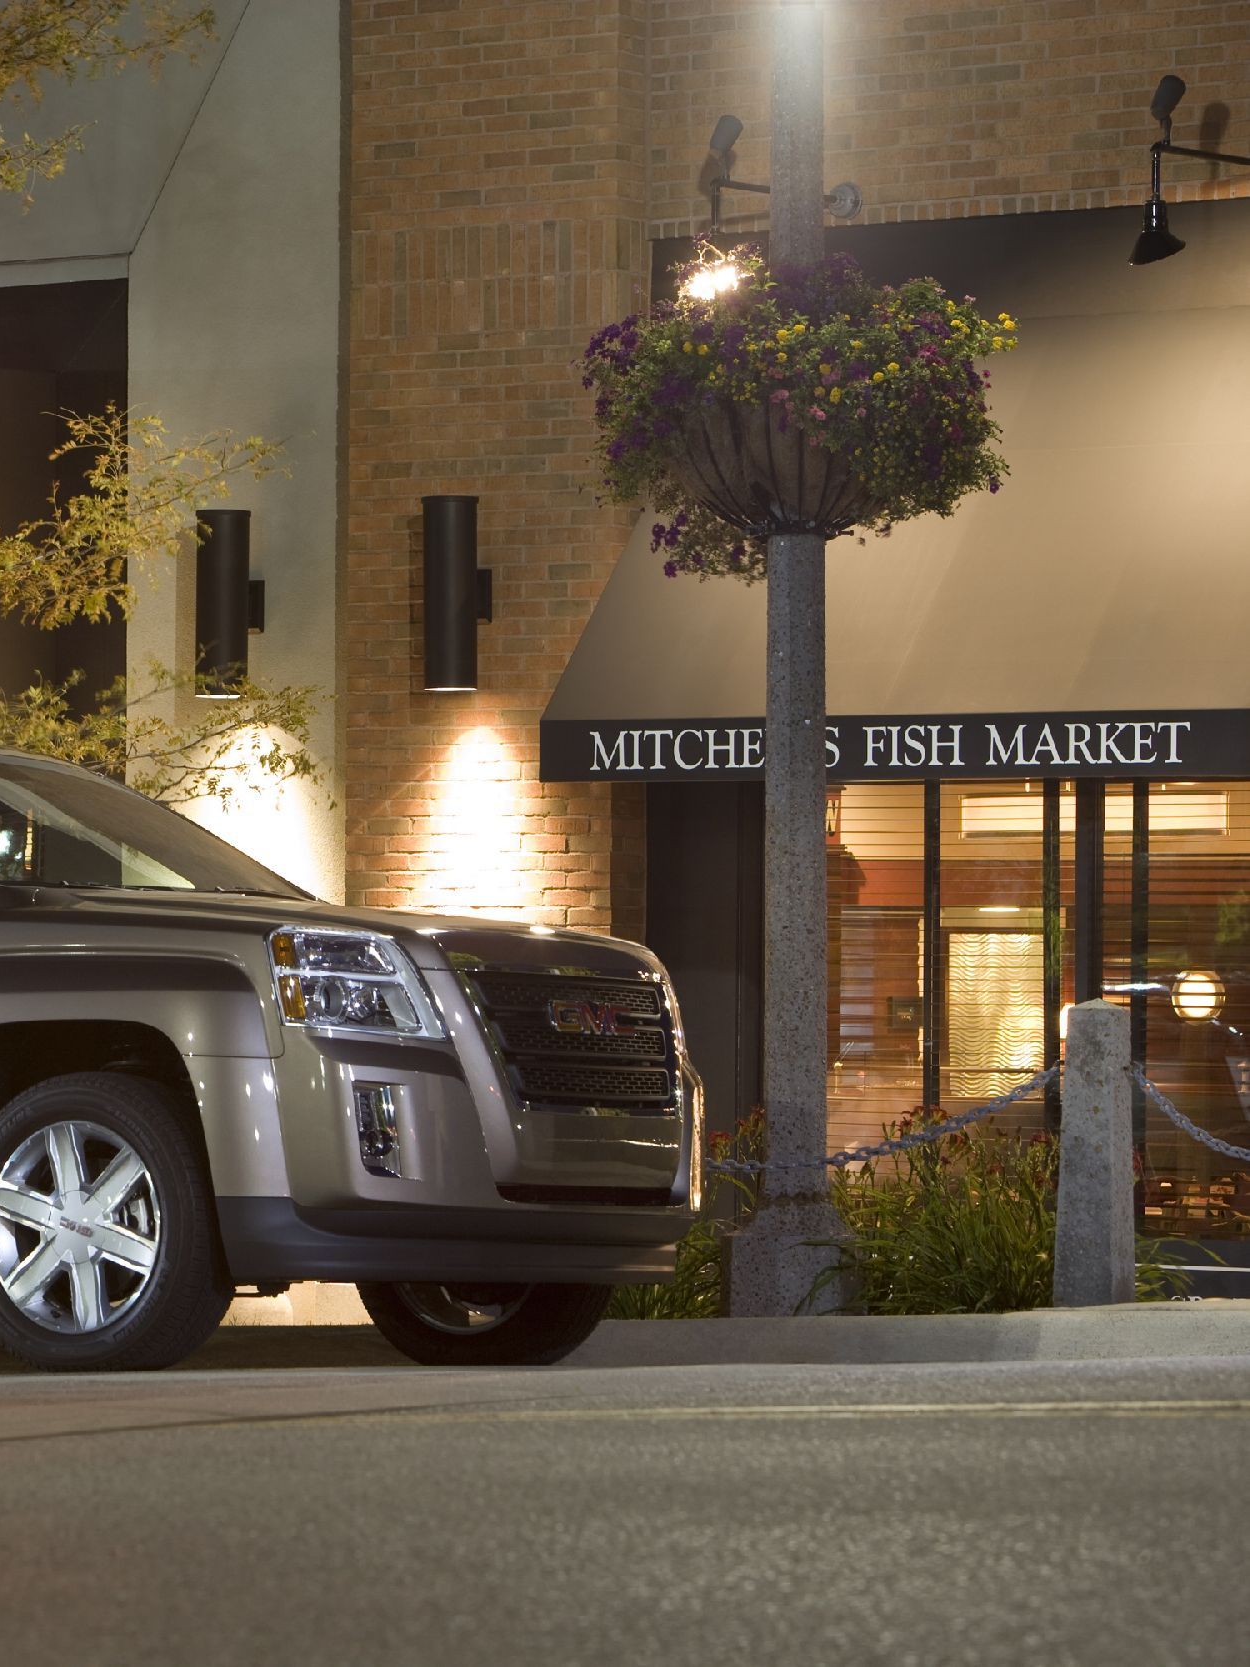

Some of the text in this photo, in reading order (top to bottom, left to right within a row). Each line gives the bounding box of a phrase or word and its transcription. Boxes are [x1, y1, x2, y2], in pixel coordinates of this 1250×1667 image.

[589, 721, 1191, 771] MITCHES FISH MARKET
[548, 1000, 638, 1036] GMC
